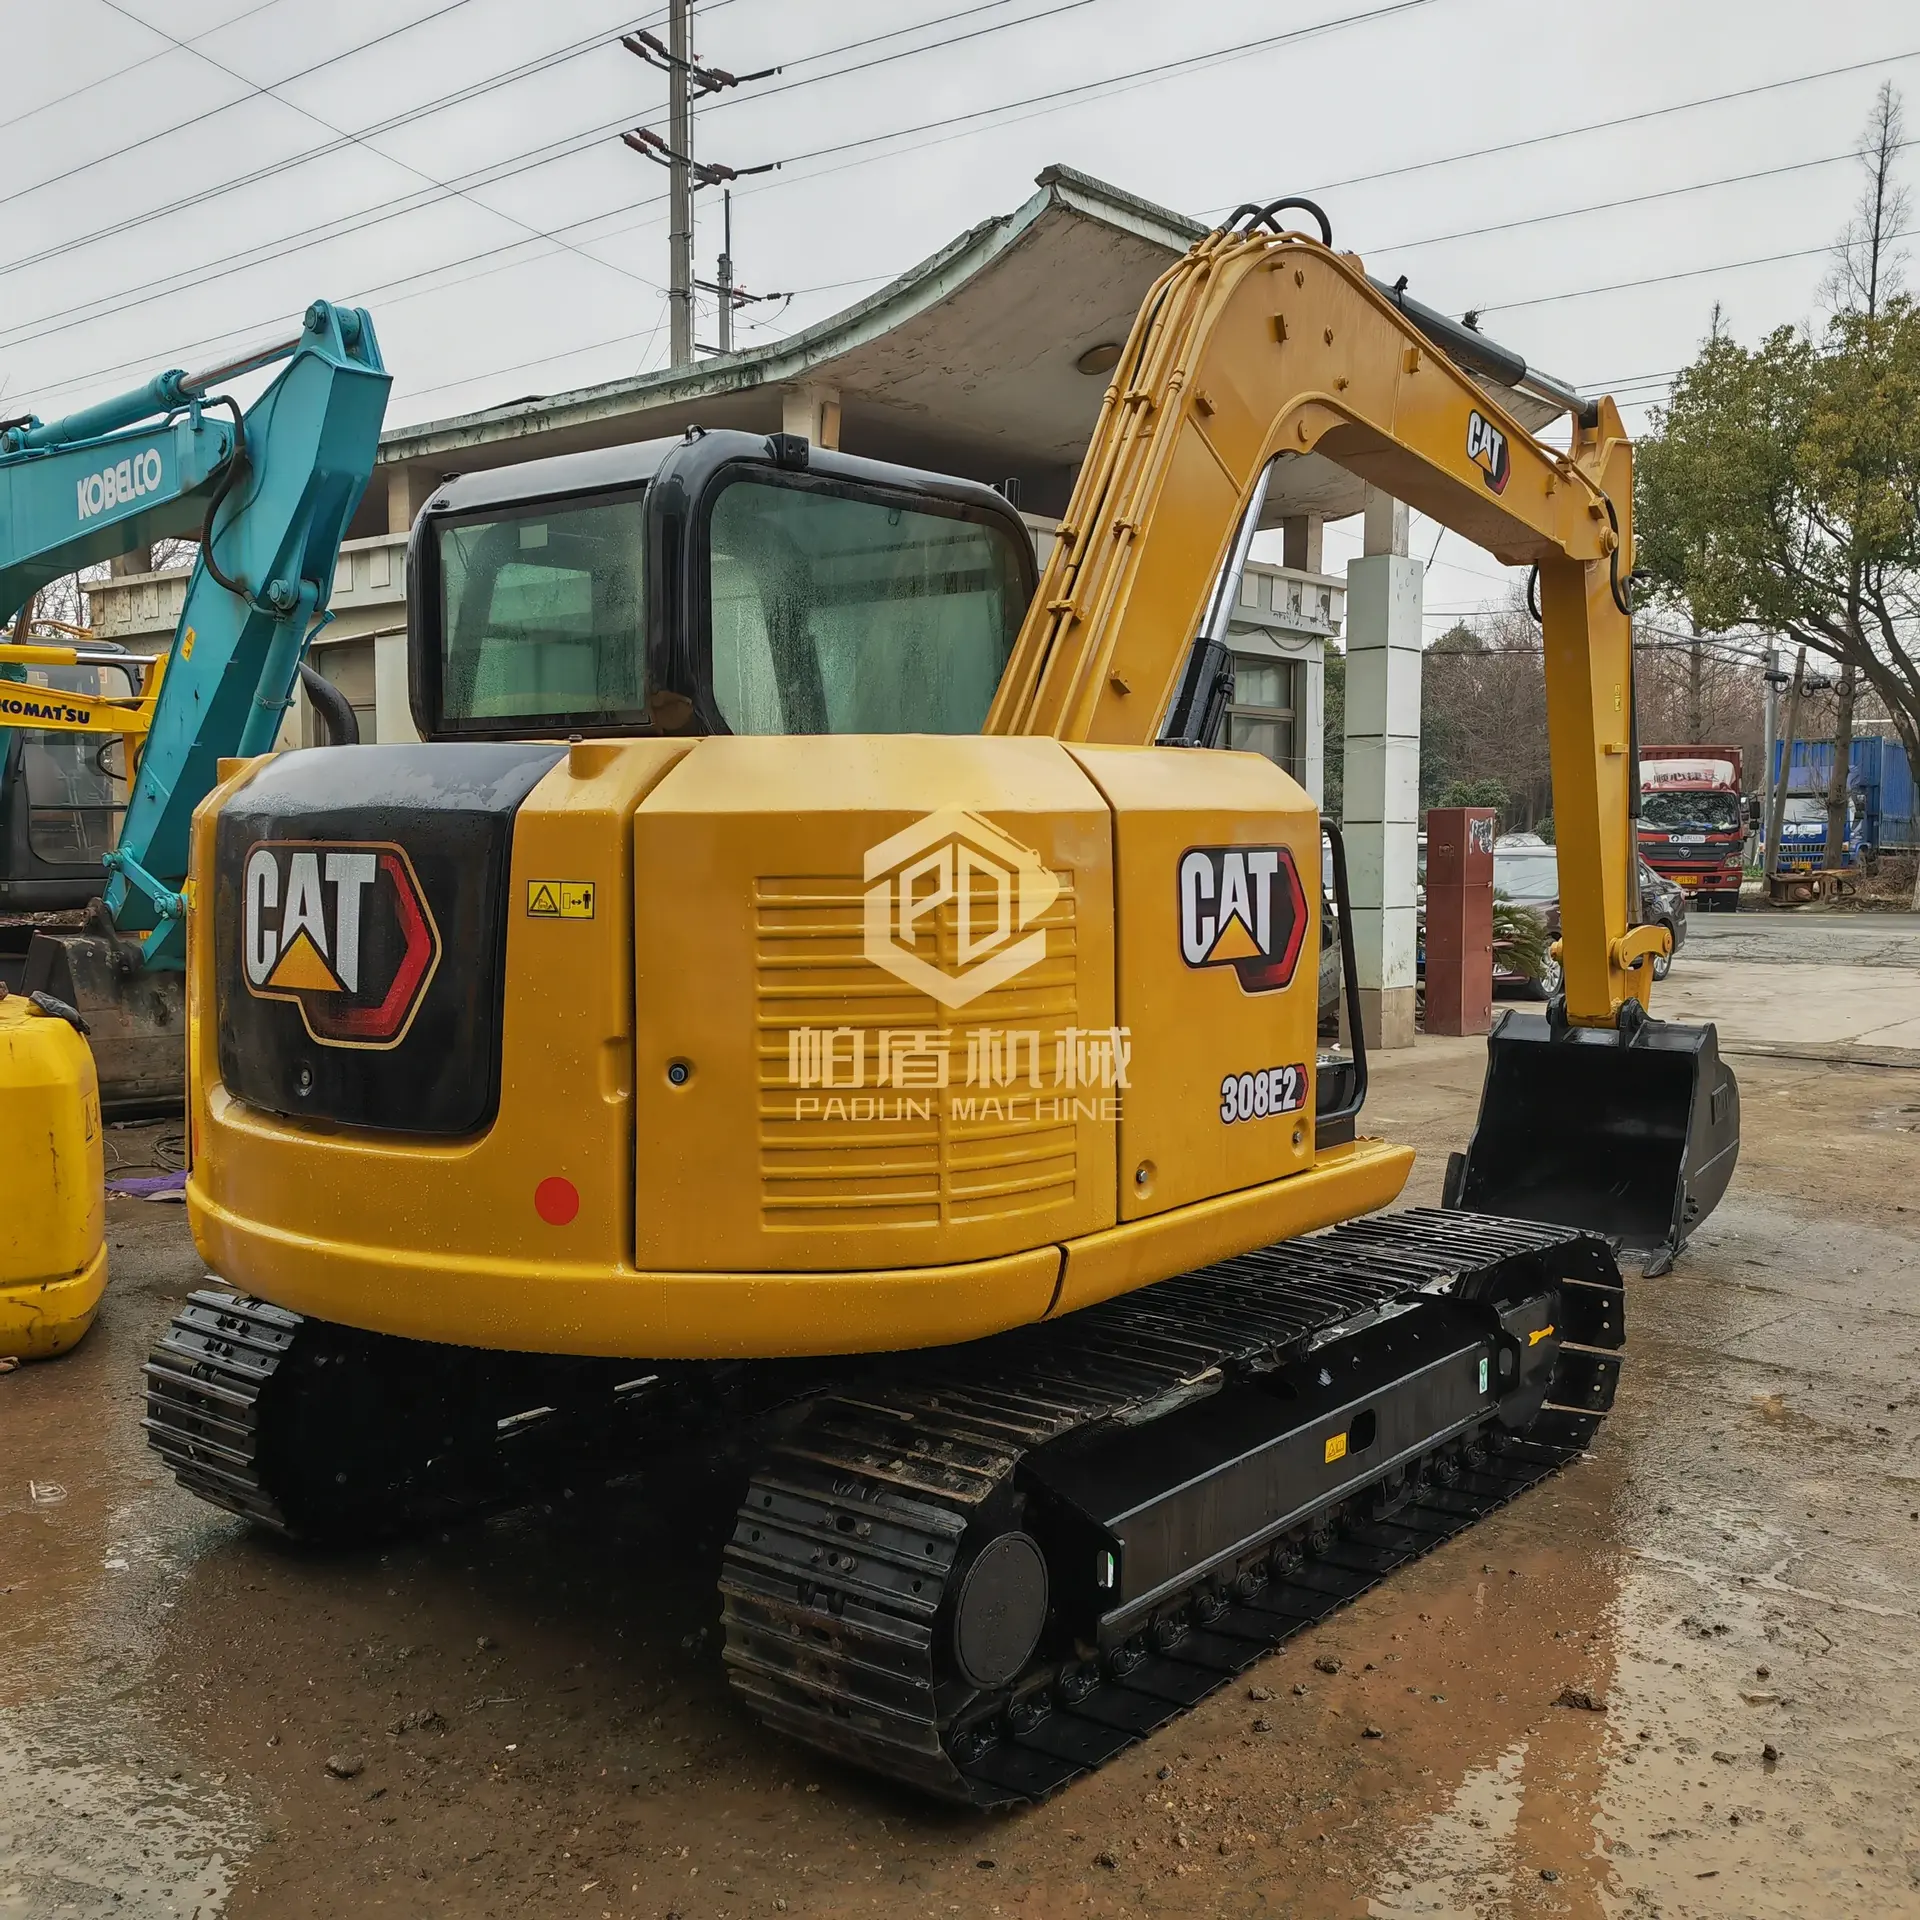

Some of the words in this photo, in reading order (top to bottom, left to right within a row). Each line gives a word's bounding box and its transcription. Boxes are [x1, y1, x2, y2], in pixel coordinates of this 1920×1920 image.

[1467, 411, 1503, 477] CAT
[77, 448, 162, 520] KOBELCO
[246, 849, 376, 993] CAT
[1181, 851, 1278, 963] CAT
[1221, 1066, 1297, 1122] 308E2
